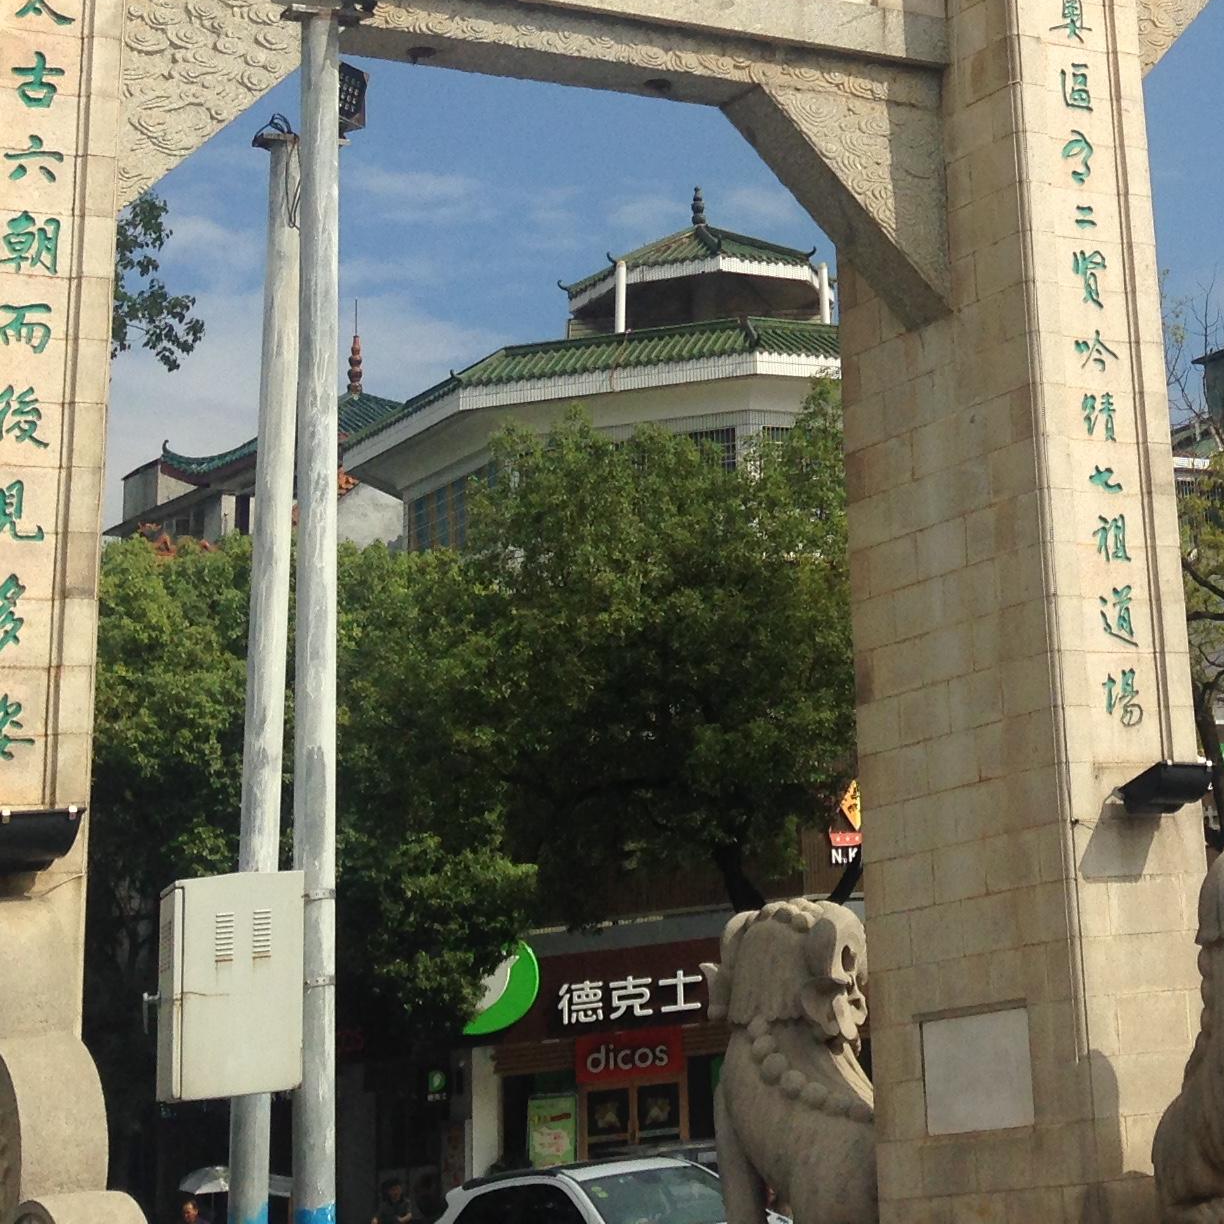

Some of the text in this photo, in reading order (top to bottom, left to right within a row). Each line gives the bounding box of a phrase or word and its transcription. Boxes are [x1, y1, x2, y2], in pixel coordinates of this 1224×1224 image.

[558, 970, 703, 1025] 德克士
[586, 1043, 670, 1074] dicos
